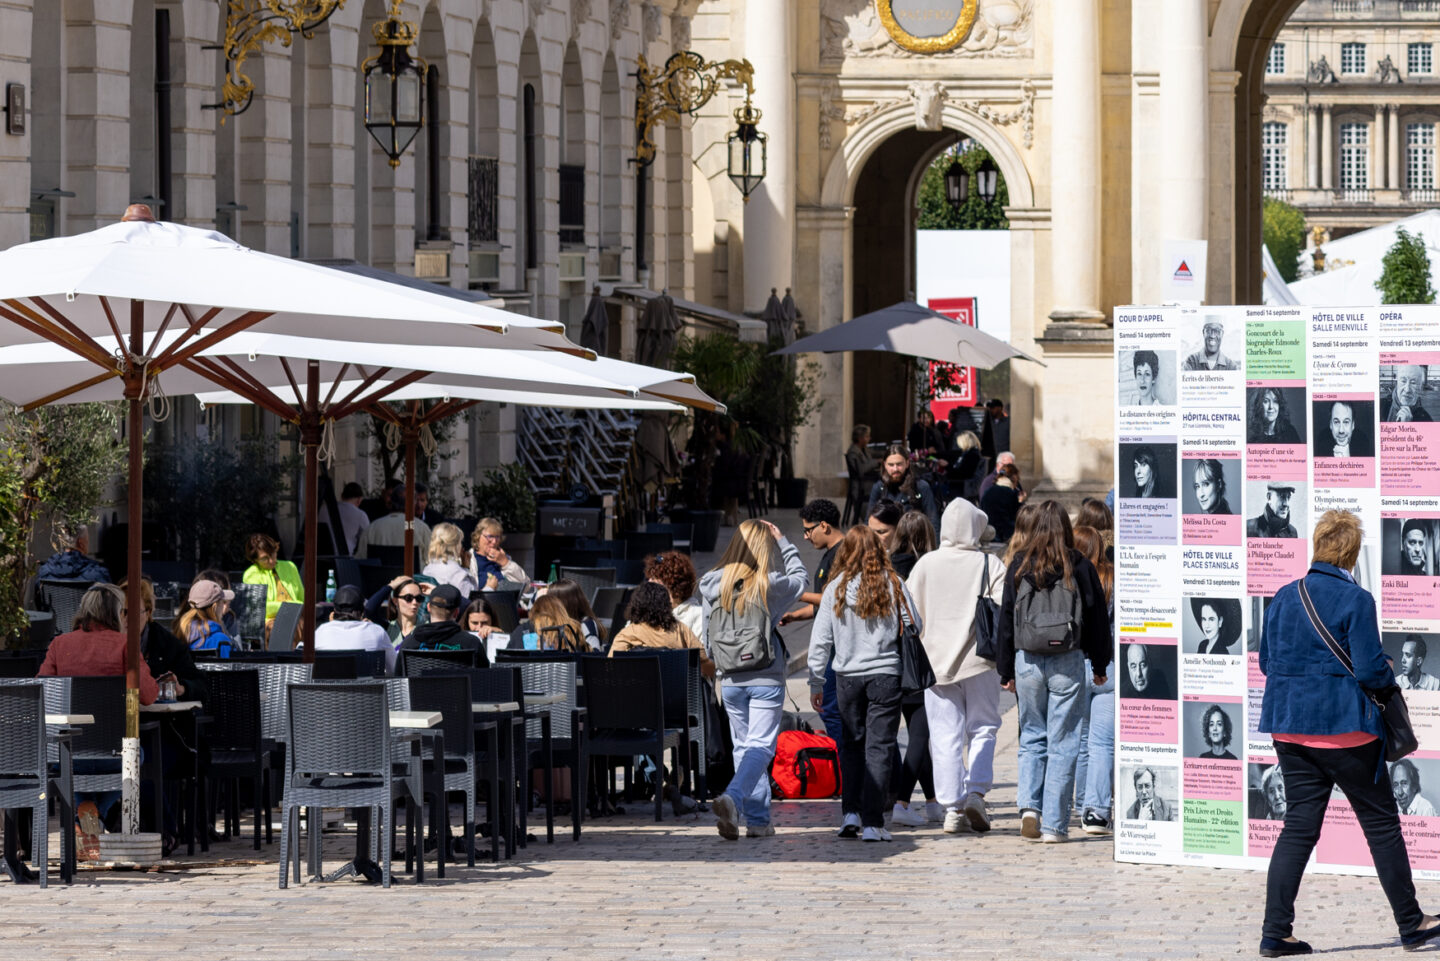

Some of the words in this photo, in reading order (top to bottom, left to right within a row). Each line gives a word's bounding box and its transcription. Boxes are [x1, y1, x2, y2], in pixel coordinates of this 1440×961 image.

[1313, 312, 1334, 322] HÔTEL
[1380, 311, 1403, 320] OPÉRA
[1183, 412, 1210, 421] HÔPITAL
[1183, 550, 1204, 559] HÔTEL
[1151, 746, 1177, 754] septembre
